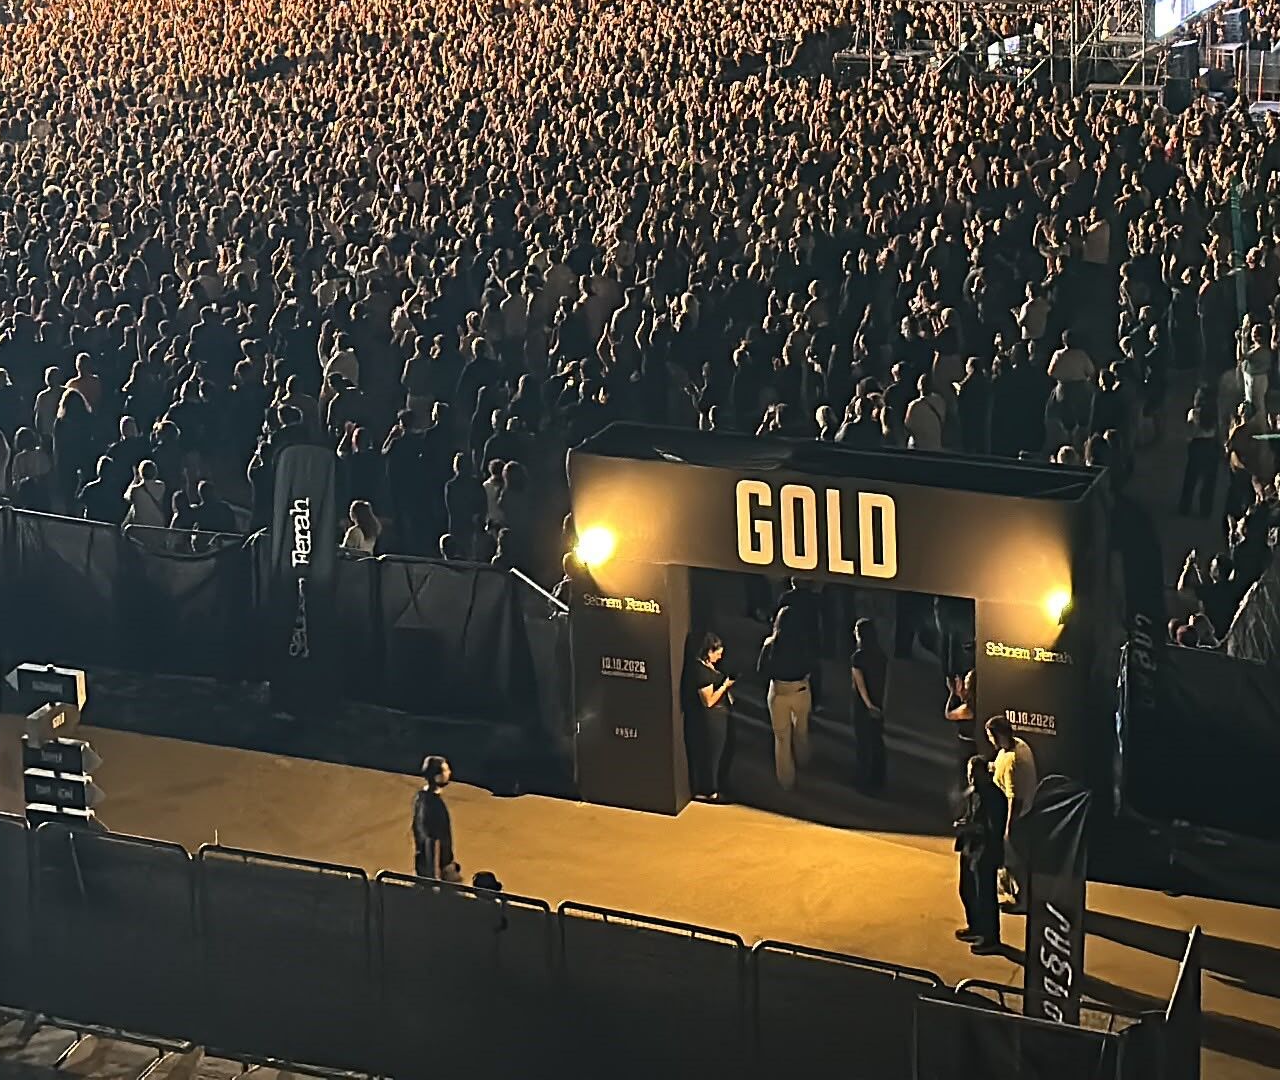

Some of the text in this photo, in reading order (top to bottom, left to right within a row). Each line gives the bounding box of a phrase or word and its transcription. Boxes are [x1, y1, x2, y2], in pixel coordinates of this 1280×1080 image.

[289, 497, 312, 568] Ferah
[736, 479, 898, 579] GOLD
[624, 597, 661, 614] Ferah
[1033, 647, 1073, 664] Ferah
[1005, 709, 1056, 729] 10.10.2026
